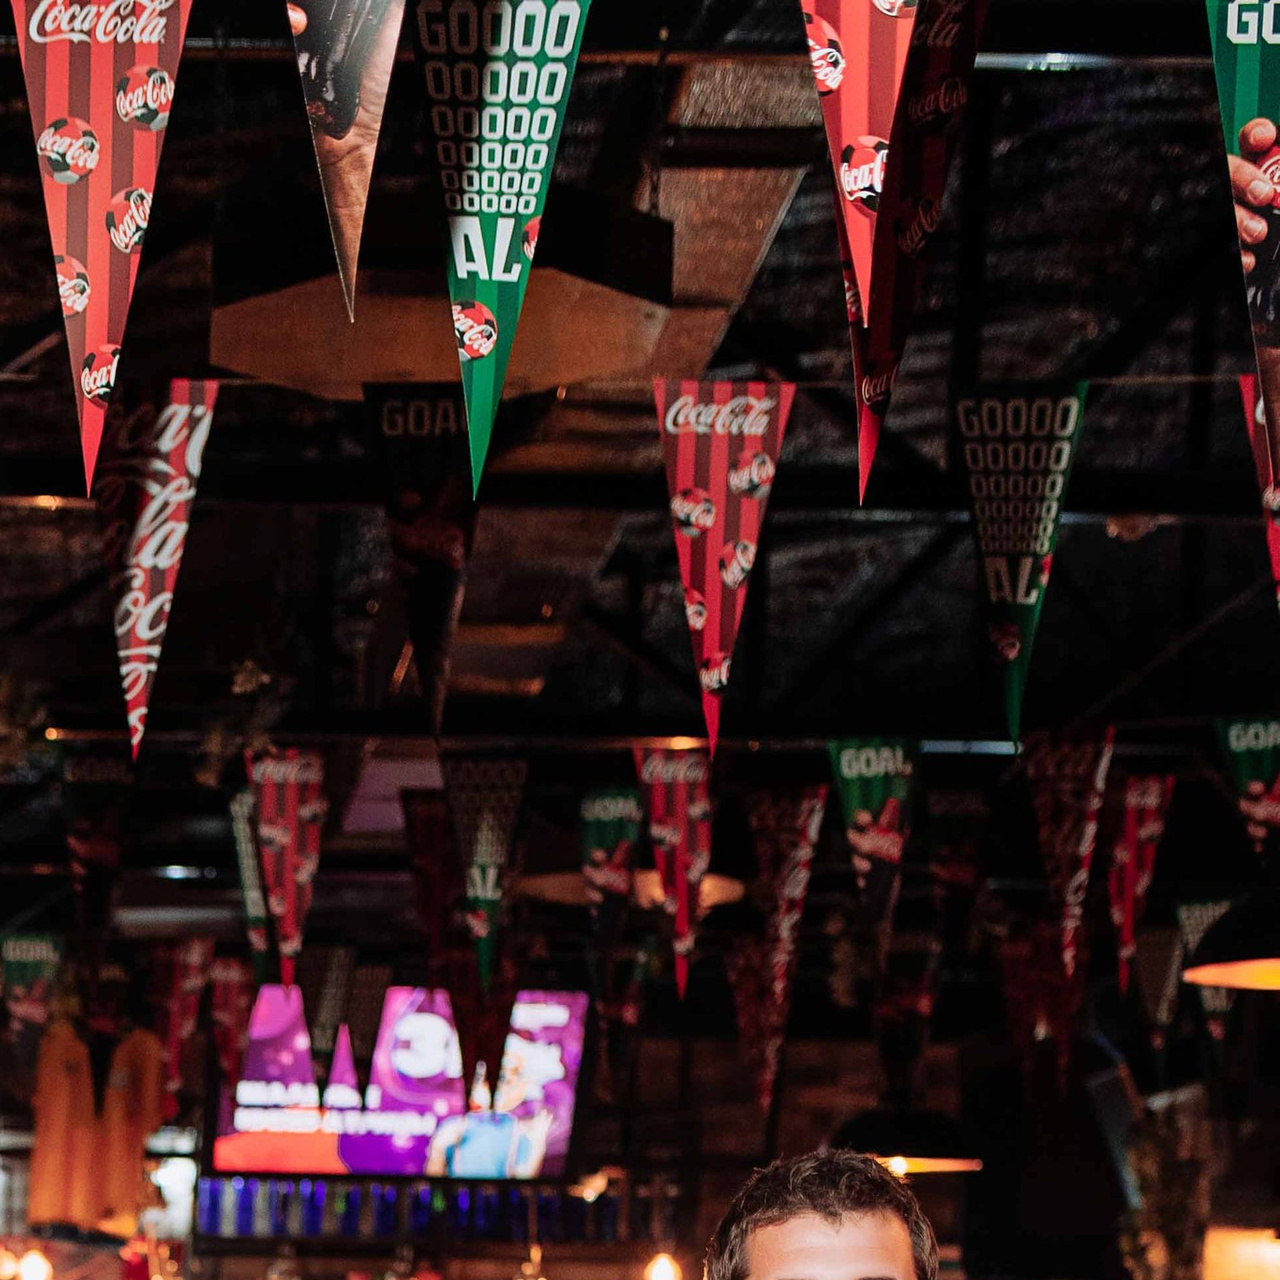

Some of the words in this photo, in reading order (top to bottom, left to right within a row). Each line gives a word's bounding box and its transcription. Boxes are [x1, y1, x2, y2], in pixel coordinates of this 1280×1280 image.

[1227, 0, 1280, 44] GO
[448, 216, 521, 282] AL
[957, 396, 1079, 437] GOOOO
[985, 556, 1039, 605] AL
